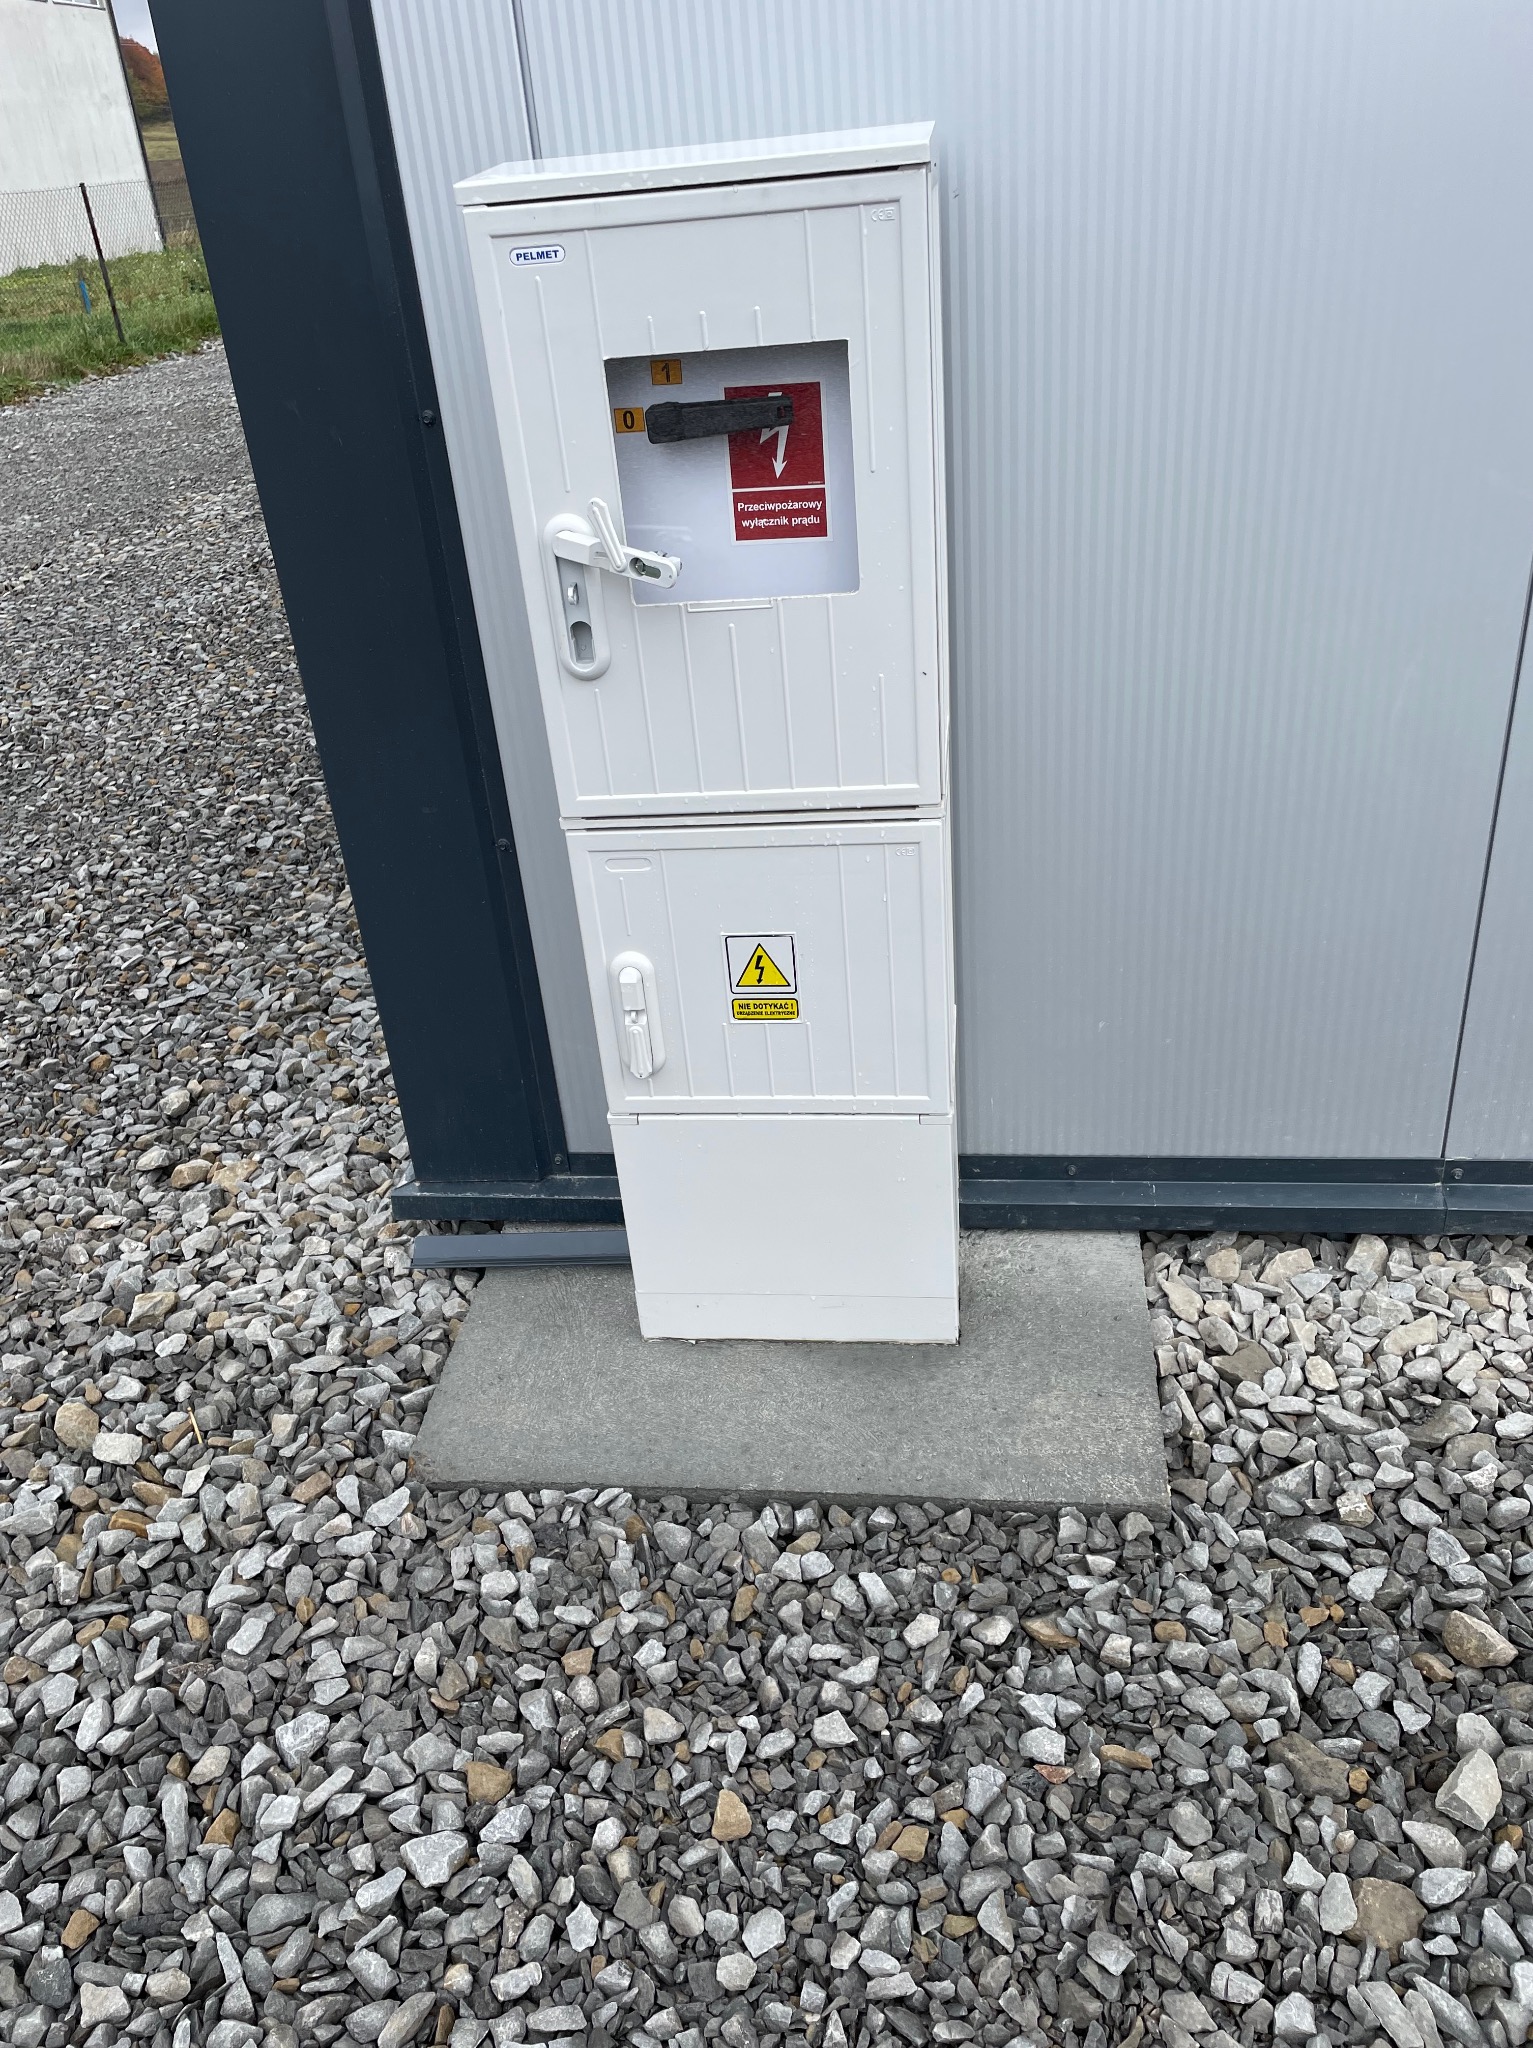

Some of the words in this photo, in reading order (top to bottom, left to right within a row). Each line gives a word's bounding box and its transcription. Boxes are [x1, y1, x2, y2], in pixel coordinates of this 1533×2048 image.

[515, 249, 560, 262] PELMET
[661, 362, 671, 383] 1
[622, 410, 635, 430] 0
[737, 500, 822, 512] Przeciwpożarowy
[741, 516, 789, 529] wyłącznik
[791, 514, 820, 527] prądu
[753, 1002, 789, 1010] DOTYKAĆ
